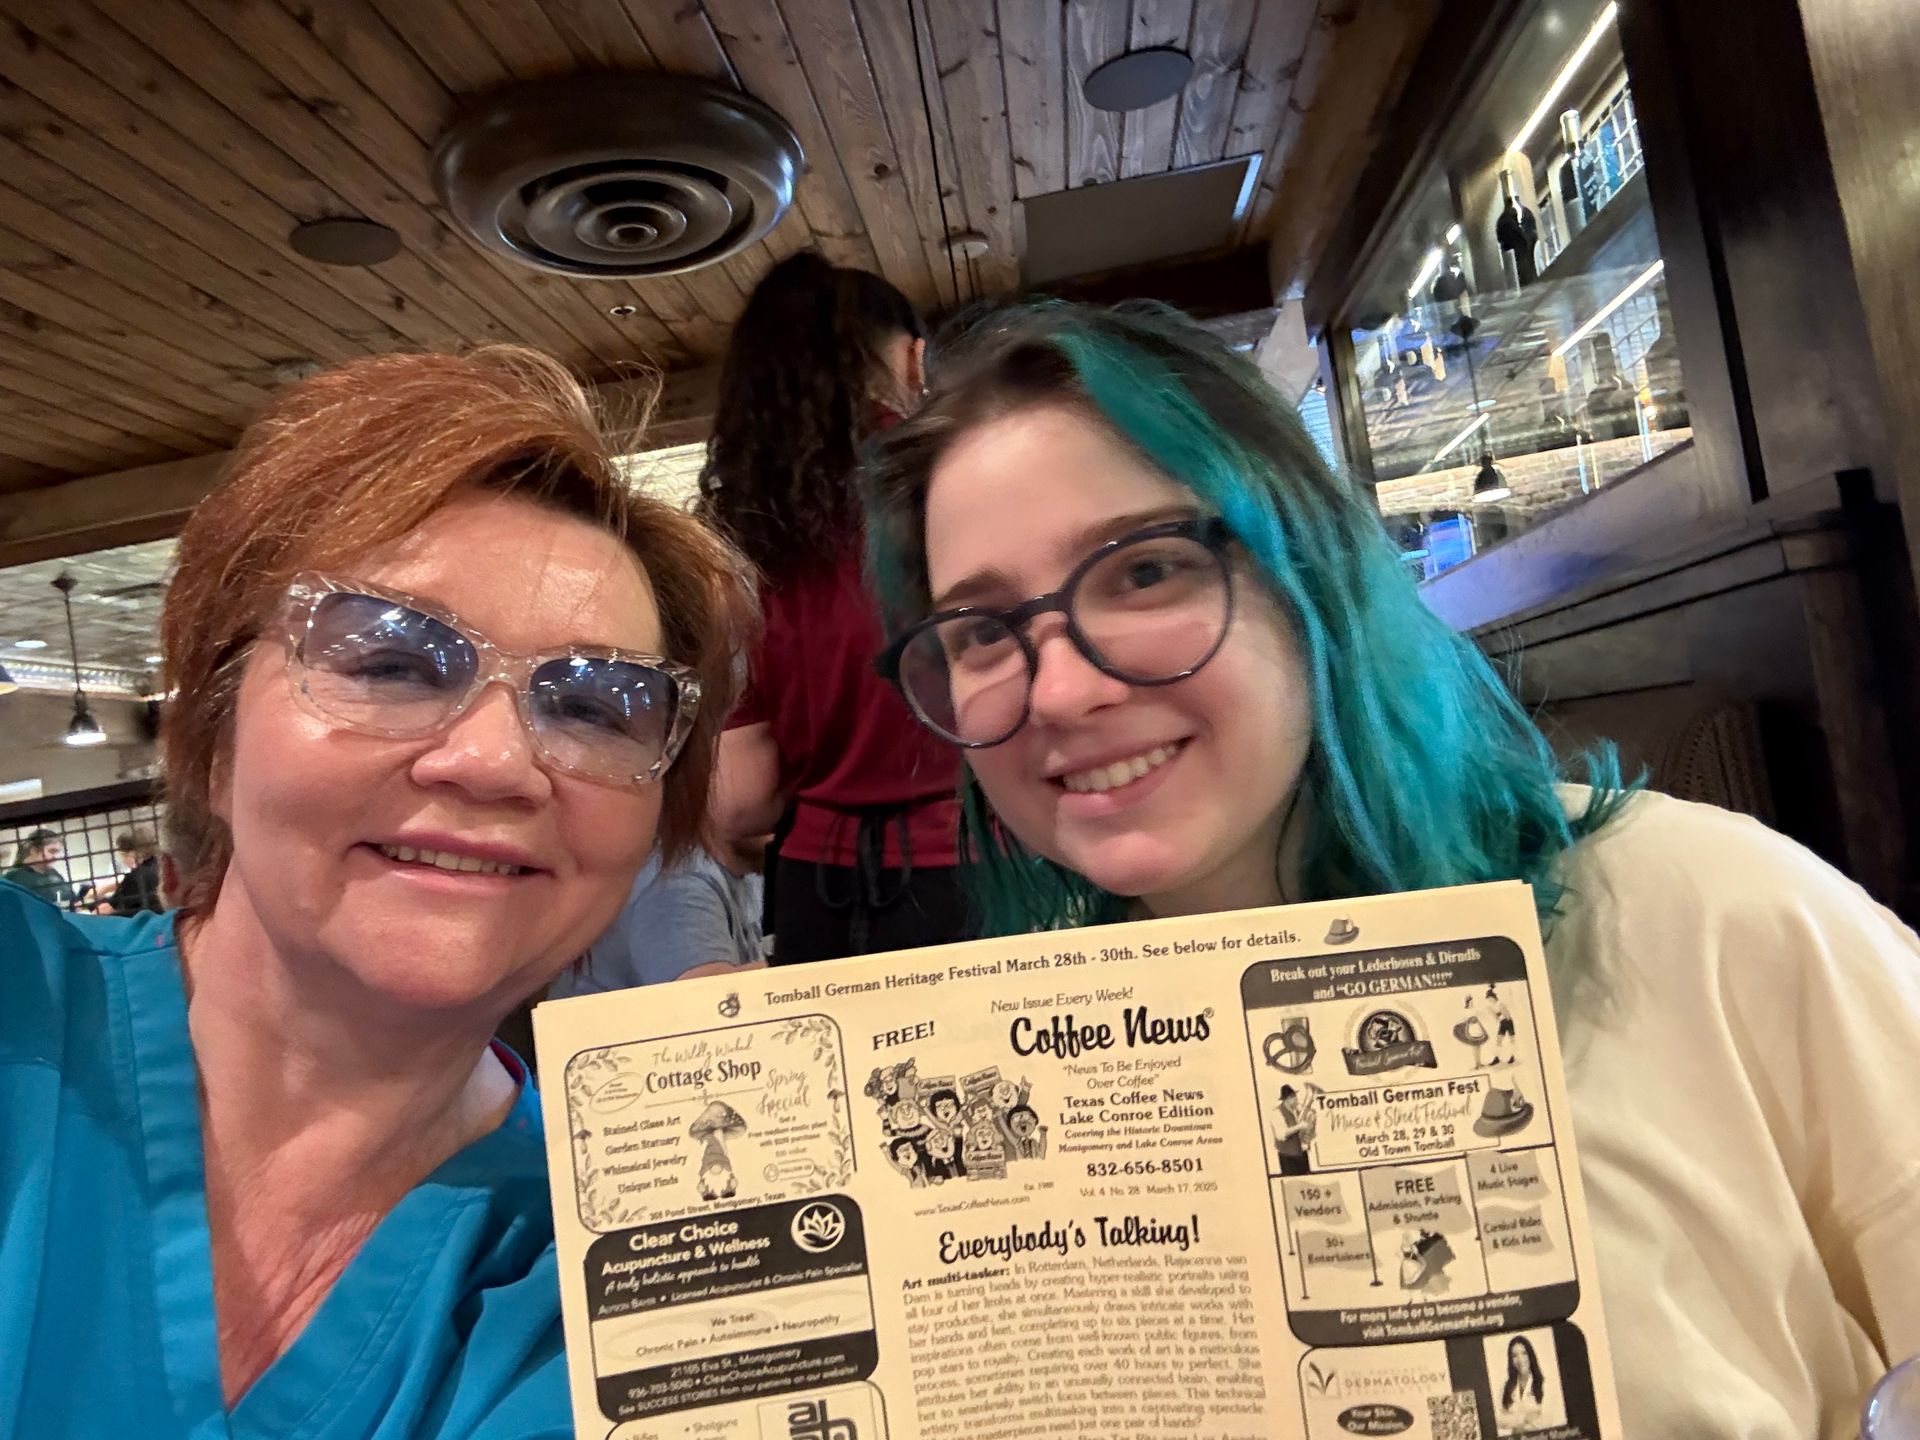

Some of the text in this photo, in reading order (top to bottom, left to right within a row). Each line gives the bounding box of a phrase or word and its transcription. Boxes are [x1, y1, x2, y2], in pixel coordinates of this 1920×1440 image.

[764, 985, 821, 1005] Tomball
[824, 981, 881, 996] German
[885, 972, 944, 989] Heritage
[948, 960, 1002, 980] Festival
[1006, 955, 1050, 973] March
[1054, 951, 1086, 967] 28th
[1100, 946, 1138, 962] 30th.
[1142, 944, 1169, 958] See
[1173, 939, 1217, 955] below
[1221, 936, 1242, 950] for
[1246, 930, 1301, 947] details.
[1270, 948, 1481, 982] Break out your Lederhosen & Dirndls
[991, 986, 1134, 1013] New Issue Every Week!
[1313, 985, 1335, 1000] and
[872, 1021, 935, 1051] FREE!
[1010, 1014, 1115, 1058] Coffee
[1100, 1061, 1114, 1073] To
[1116, 1062, 1130, 1074] Be
[1135, 1055, 1181, 1072] Enjoyed
[646, 1068, 712, 1094] Cottage
[718, 1059, 761, 1082] Shop
[1086, 1078, 1115, 1090] Over
[1064, 1089, 1204, 1108] Texas Coffee News
[1317, 1079, 1480, 1110] Tomball German Fest
[1059, 1105, 1214, 1125] Lake Conroe Edition
[1327, 1106, 1370, 1132] Music
[1384, 1104, 1420, 1129] Street
[1420, 1095, 1471, 1125] Festival
[1064, 1123, 1212, 1139] Covering the Historic Downtown
[1355, 1125, 1455, 1145] March 28, 29 & 30
[1058, 1143, 1113, 1154] Montgomery
[1116, 1140, 1133, 1150] and
[1135, 1139, 1157, 1149] Lake
[1159, 1137, 1194, 1148] Conroe
[1358, 1136, 1455, 1158] Old Town Tomball
[1087, 1158, 1203, 1177] 832-656-8501
[1498, 1163, 1518, 1174] Live
[1099, 1187, 1106, 1196] 4
[1128, 1186, 1140, 1196] 28
[1146, 1183, 1175, 1194] March
[1395, 1177, 1435, 1195] FREE
[1477, 1175, 1539, 1191] Music Stages
[764, 1192, 786, 1201] Texas
[1300, 1188, 1321, 1200] 150
[1424, 1194, 1462, 1206] Parking
[1294, 1204, 1342, 1217] Vendors
[629, 1221, 738, 1251] Clear Choice
[939, 1214, 1200, 1265] Everybody's Talking!
[602, 1237, 770, 1276] Acupuncture & Wellness
[720, 1263, 729, 1272] to
[902, 1279, 922, 1290] Art
[927, 1267, 1010, 1287] multi-tasker:
[903, 1294, 931, 1306] Dam
[1344, 1374, 1446, 1389] DERMATOLOGY
